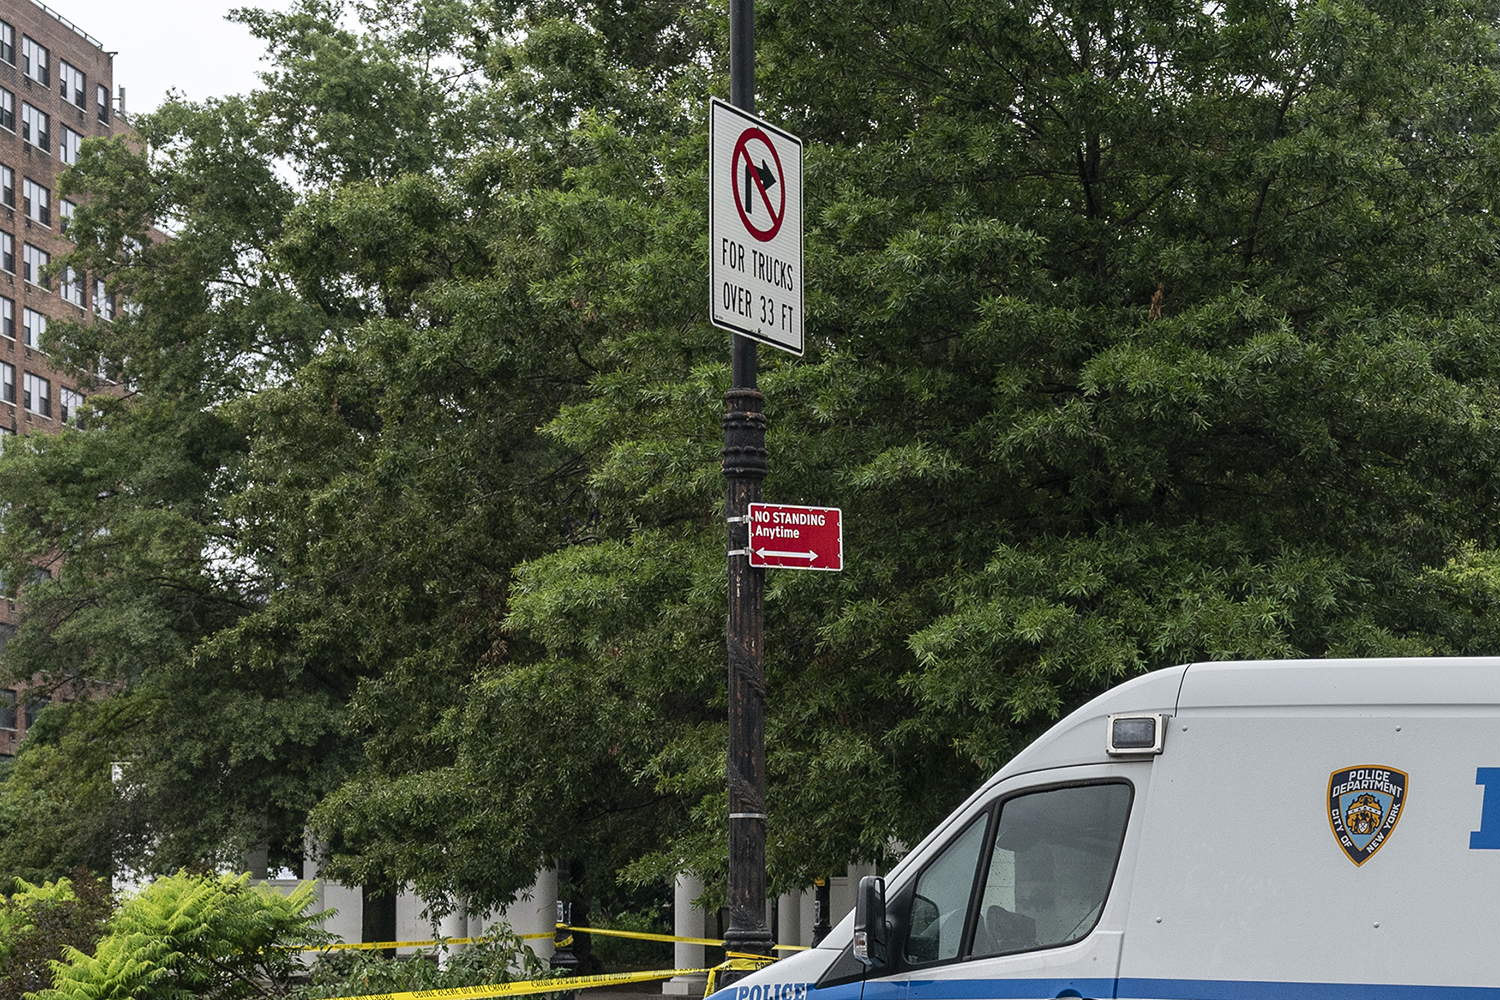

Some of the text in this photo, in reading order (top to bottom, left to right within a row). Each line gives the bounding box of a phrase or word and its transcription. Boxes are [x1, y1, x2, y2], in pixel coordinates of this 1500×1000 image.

[722, 237, 793, 292] FOR TRUCKS
[723, 281, 794, 333] OVER 33 FT
[755, 511, 826, 526] NO STANDING
[755, 525, 800, 540] Anytime
[1349, 769, 1391, 782] POLICE
[1332, 780, 1403, 798] DEPARTMENT
[1331, 803, 1401, 853] CITY OF NEW YORK
